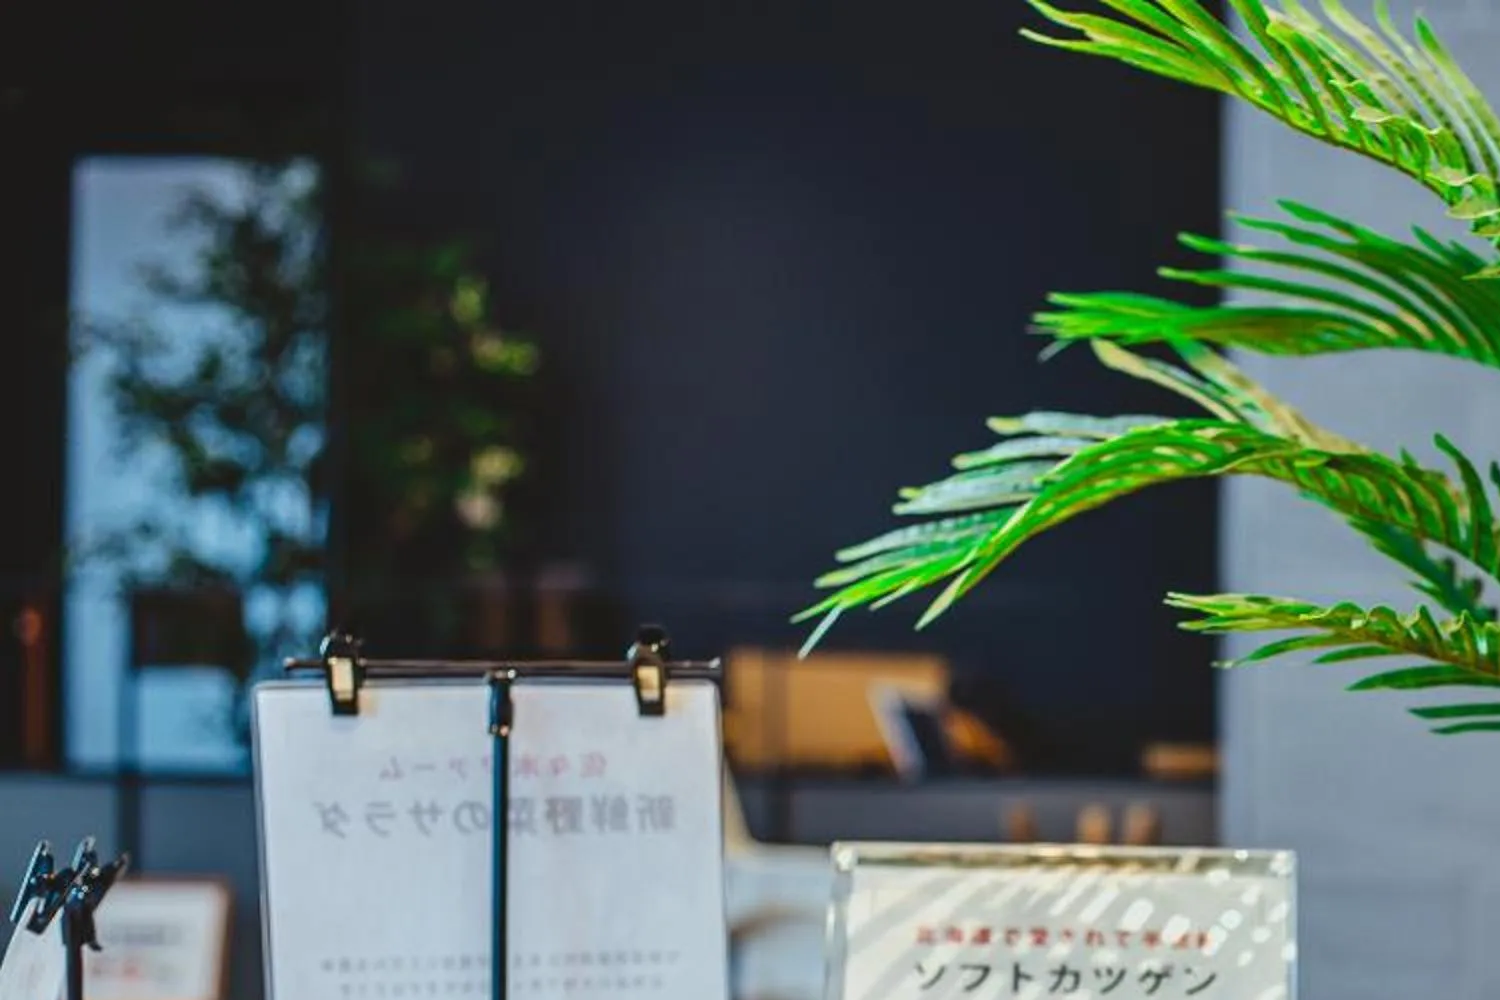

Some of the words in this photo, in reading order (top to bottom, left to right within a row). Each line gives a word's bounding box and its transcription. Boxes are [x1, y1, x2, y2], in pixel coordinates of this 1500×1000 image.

[914, 962, 1218, 996] ソフトカツゲン
